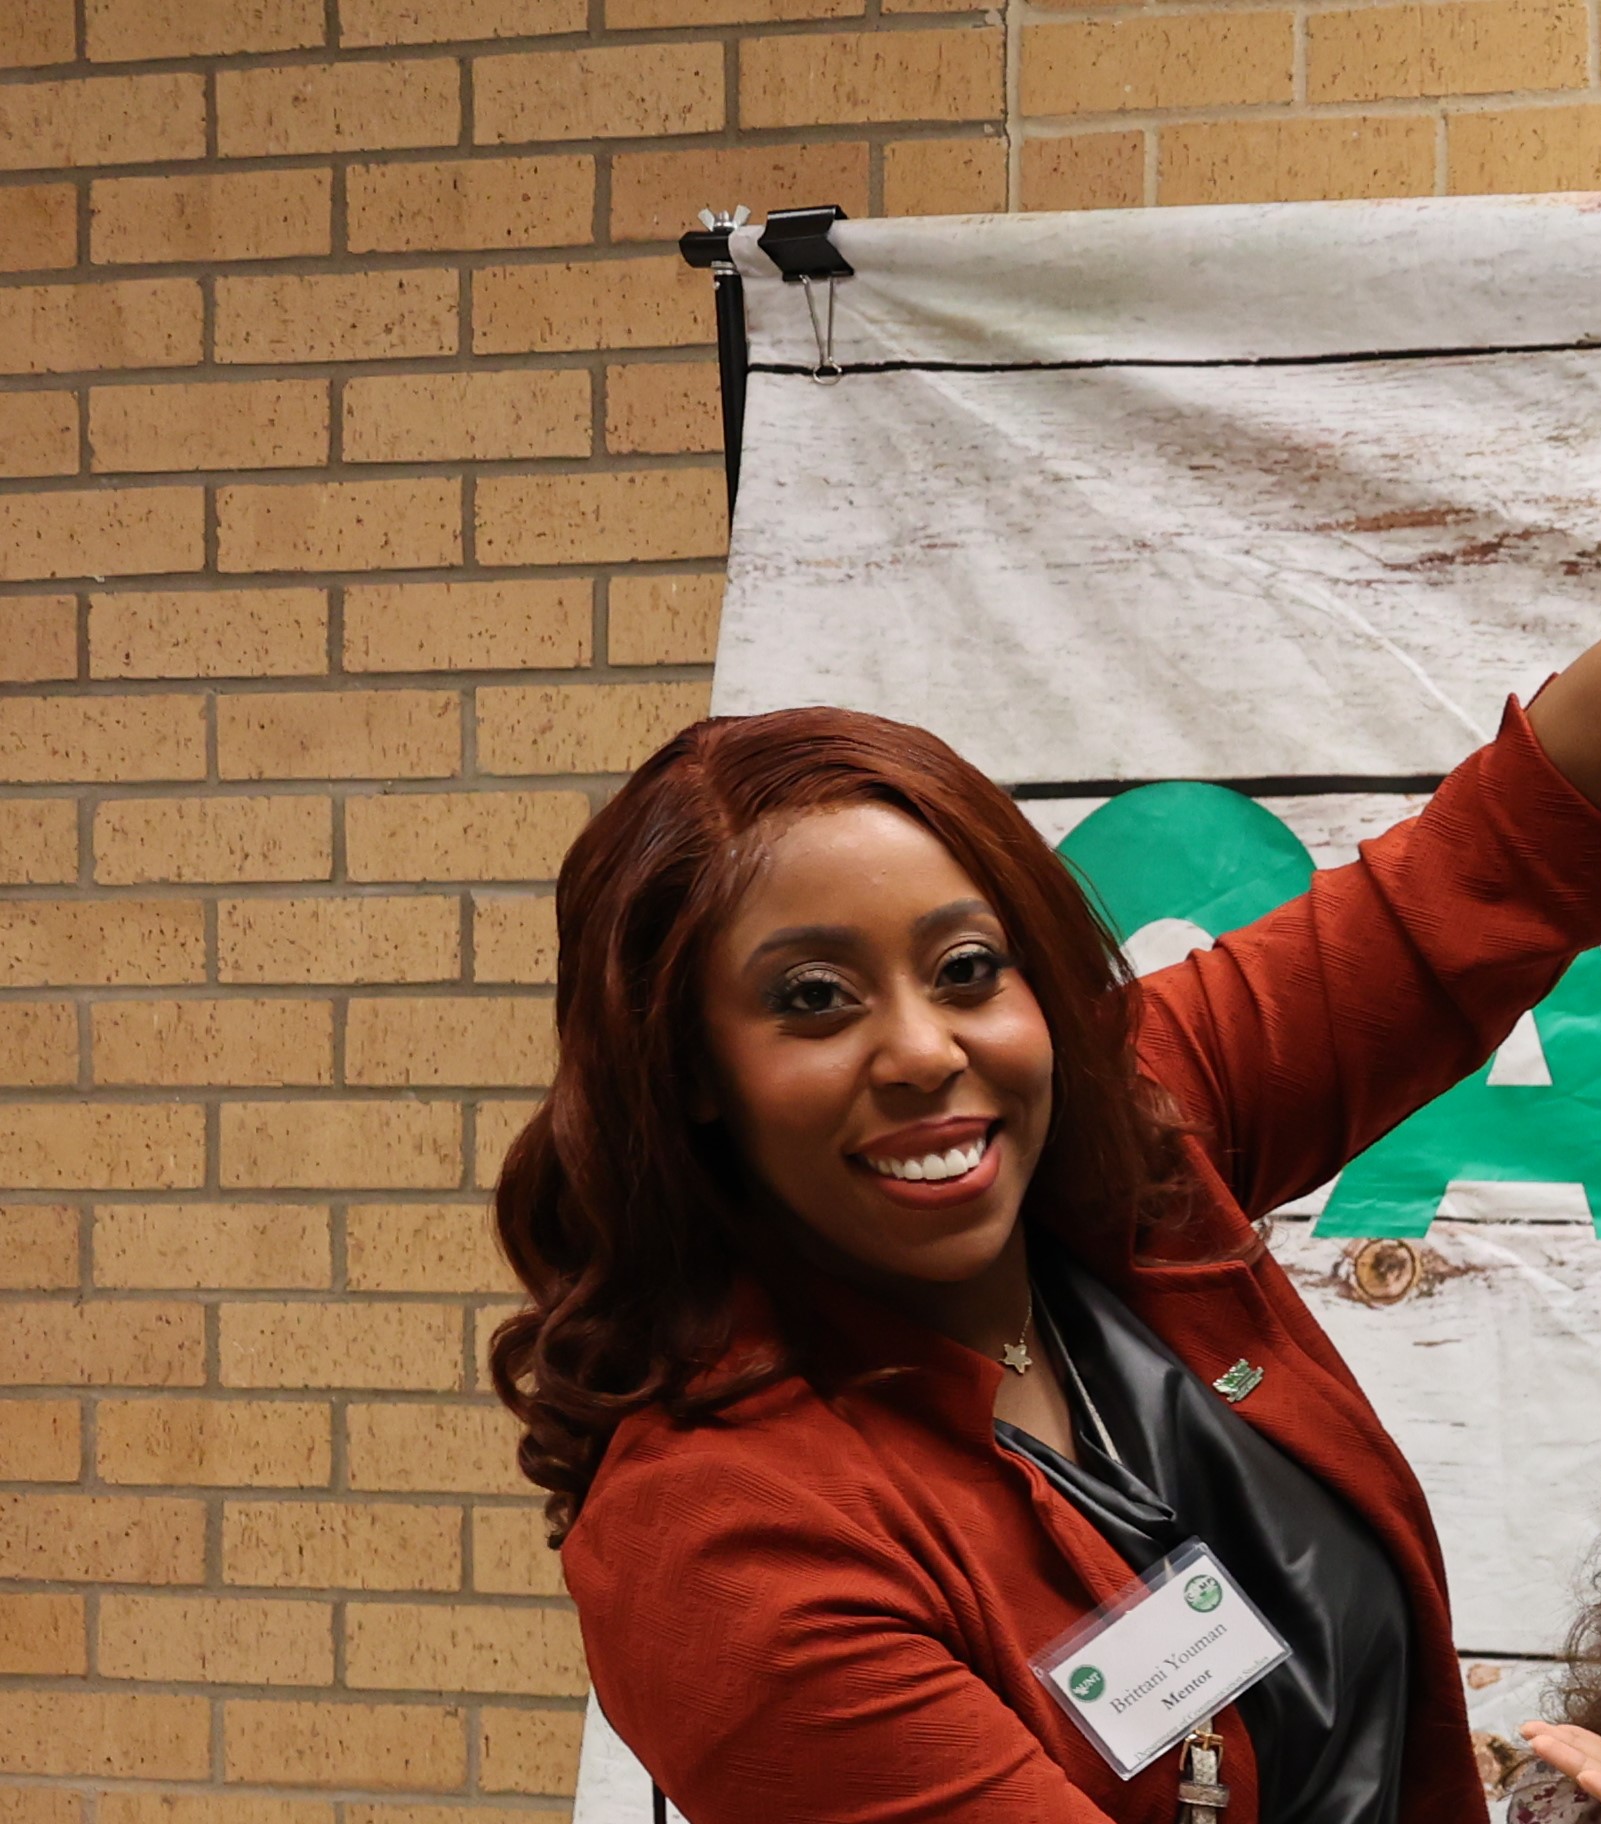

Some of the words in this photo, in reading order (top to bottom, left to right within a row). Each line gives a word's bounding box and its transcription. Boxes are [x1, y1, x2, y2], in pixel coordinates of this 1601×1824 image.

[1110, 1667, 1168, 1714] Brittani
[1164, 1623, 1228, 1671] Youman
[1161, 1669, 1213, 1710] Mentor
